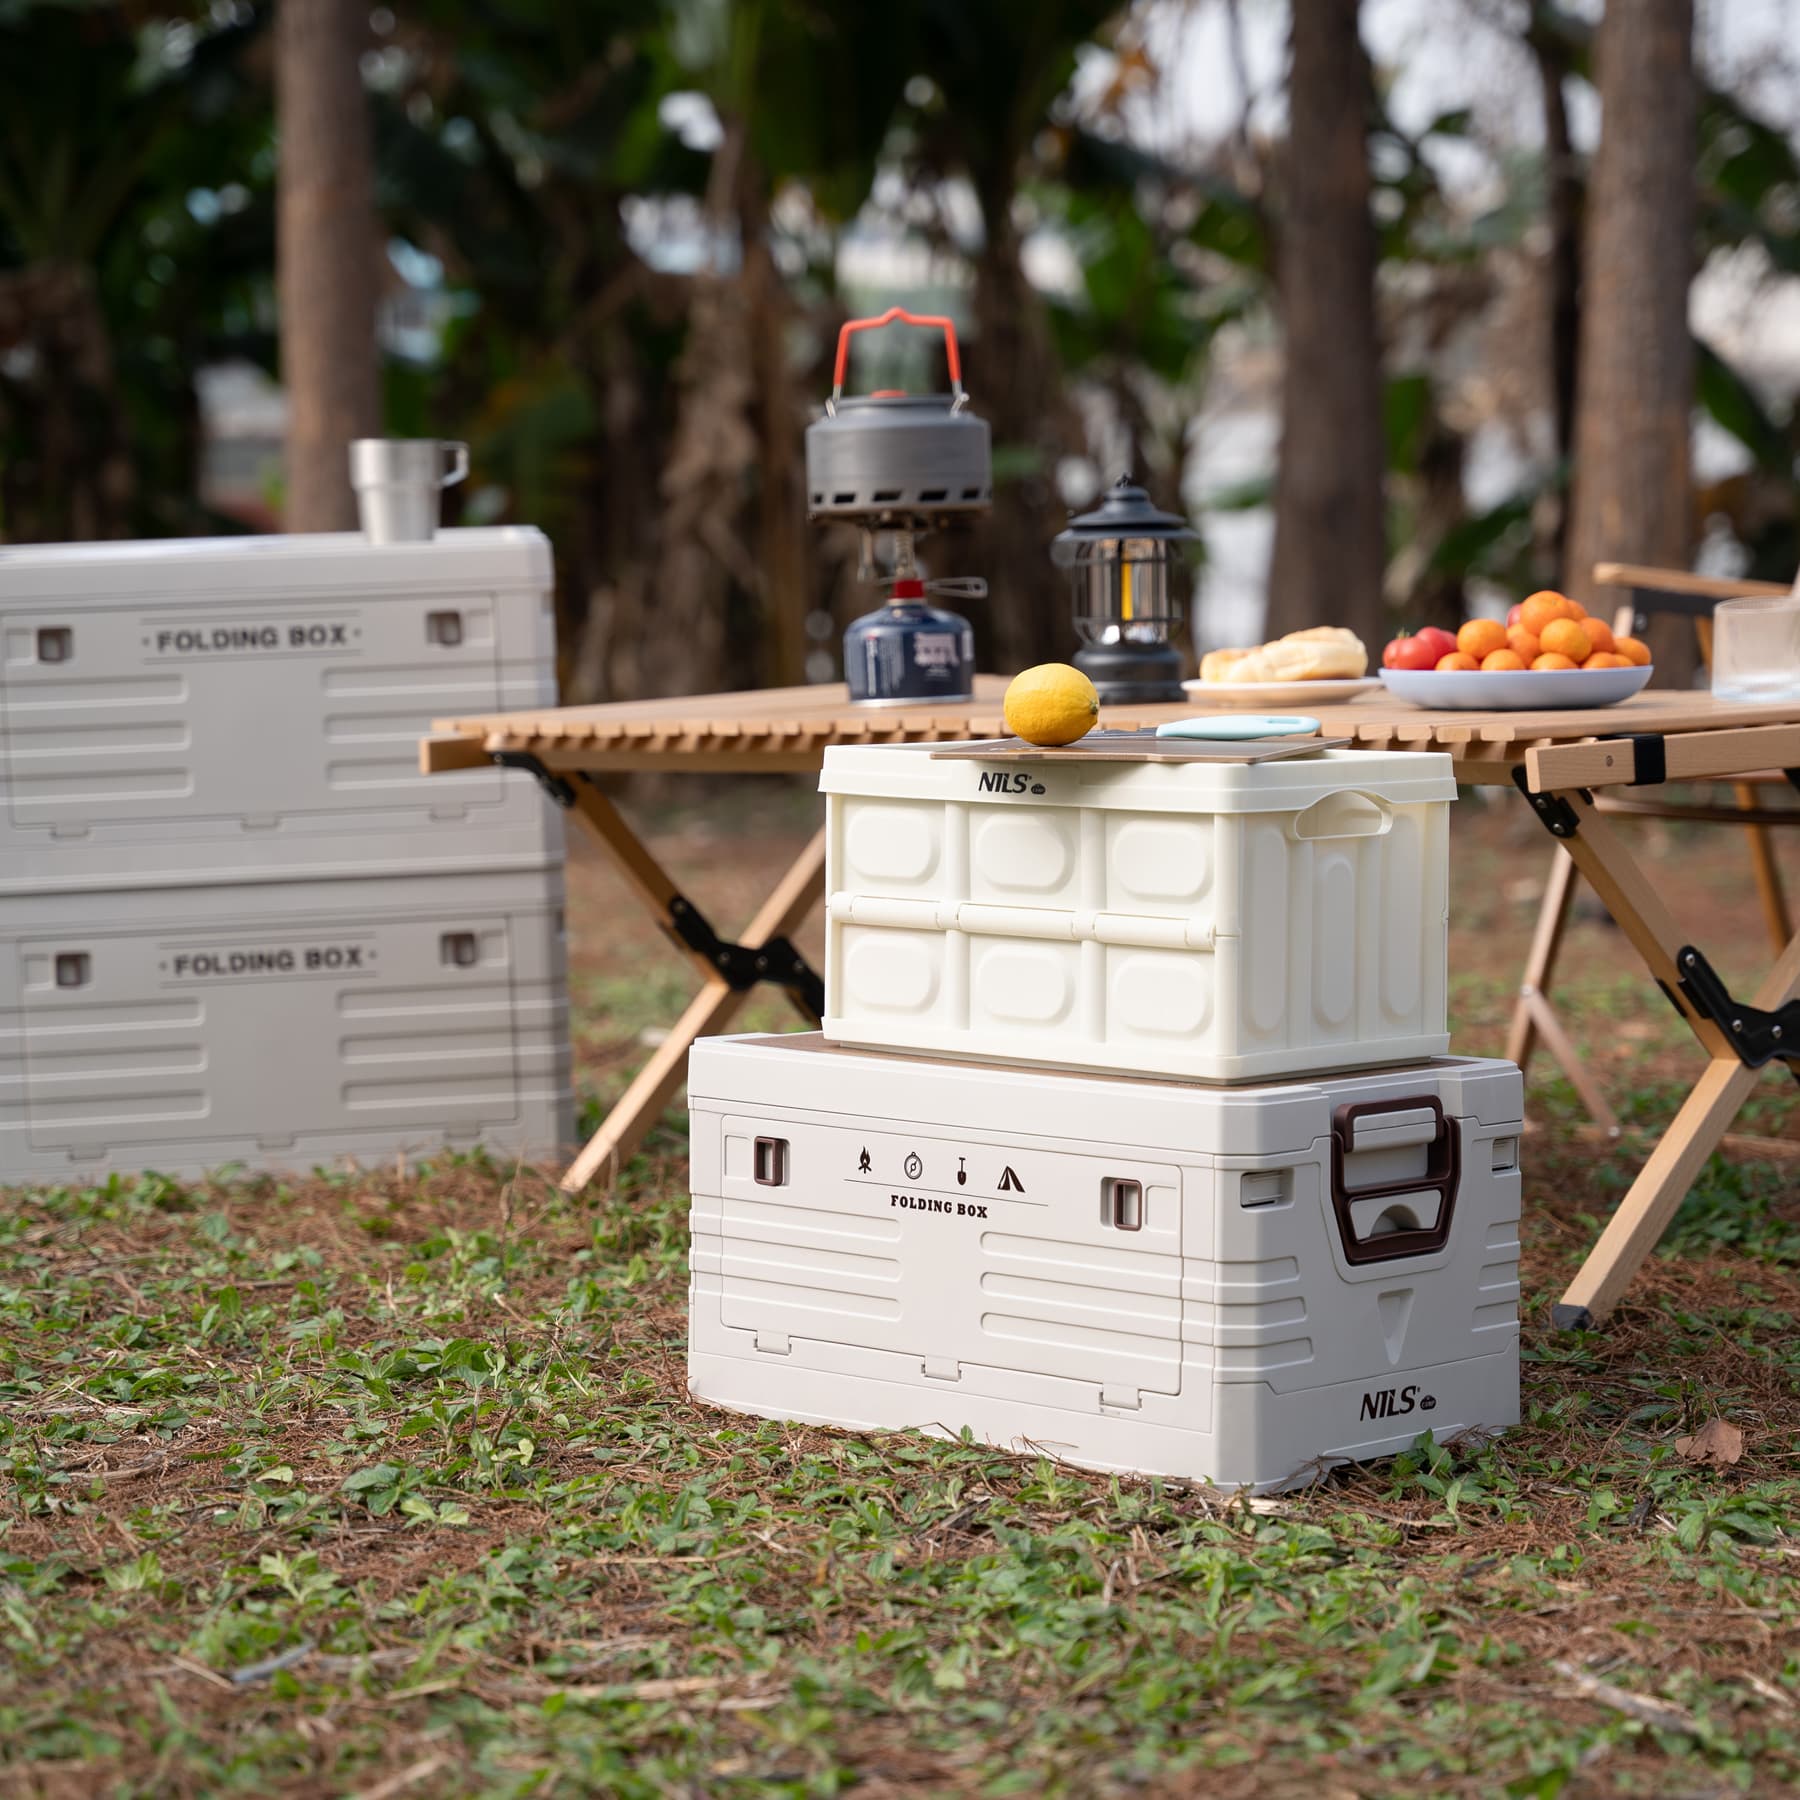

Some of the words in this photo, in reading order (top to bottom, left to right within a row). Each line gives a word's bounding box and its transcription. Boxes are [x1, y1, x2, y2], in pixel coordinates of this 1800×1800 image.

[157, 626, 278, 652] FOLDING
[289, 624, 347, 647] BOX
[978, 771, 1028, 793] NILS
[174, 949, 295, 976] FOLDING
[305, 946, 362, 969] BOX
[891, 1195, 953, 1214] FOLDING
[957, 1203, 988, 1219] BOX
[1360, 1385, 1417, 1422] NILS
